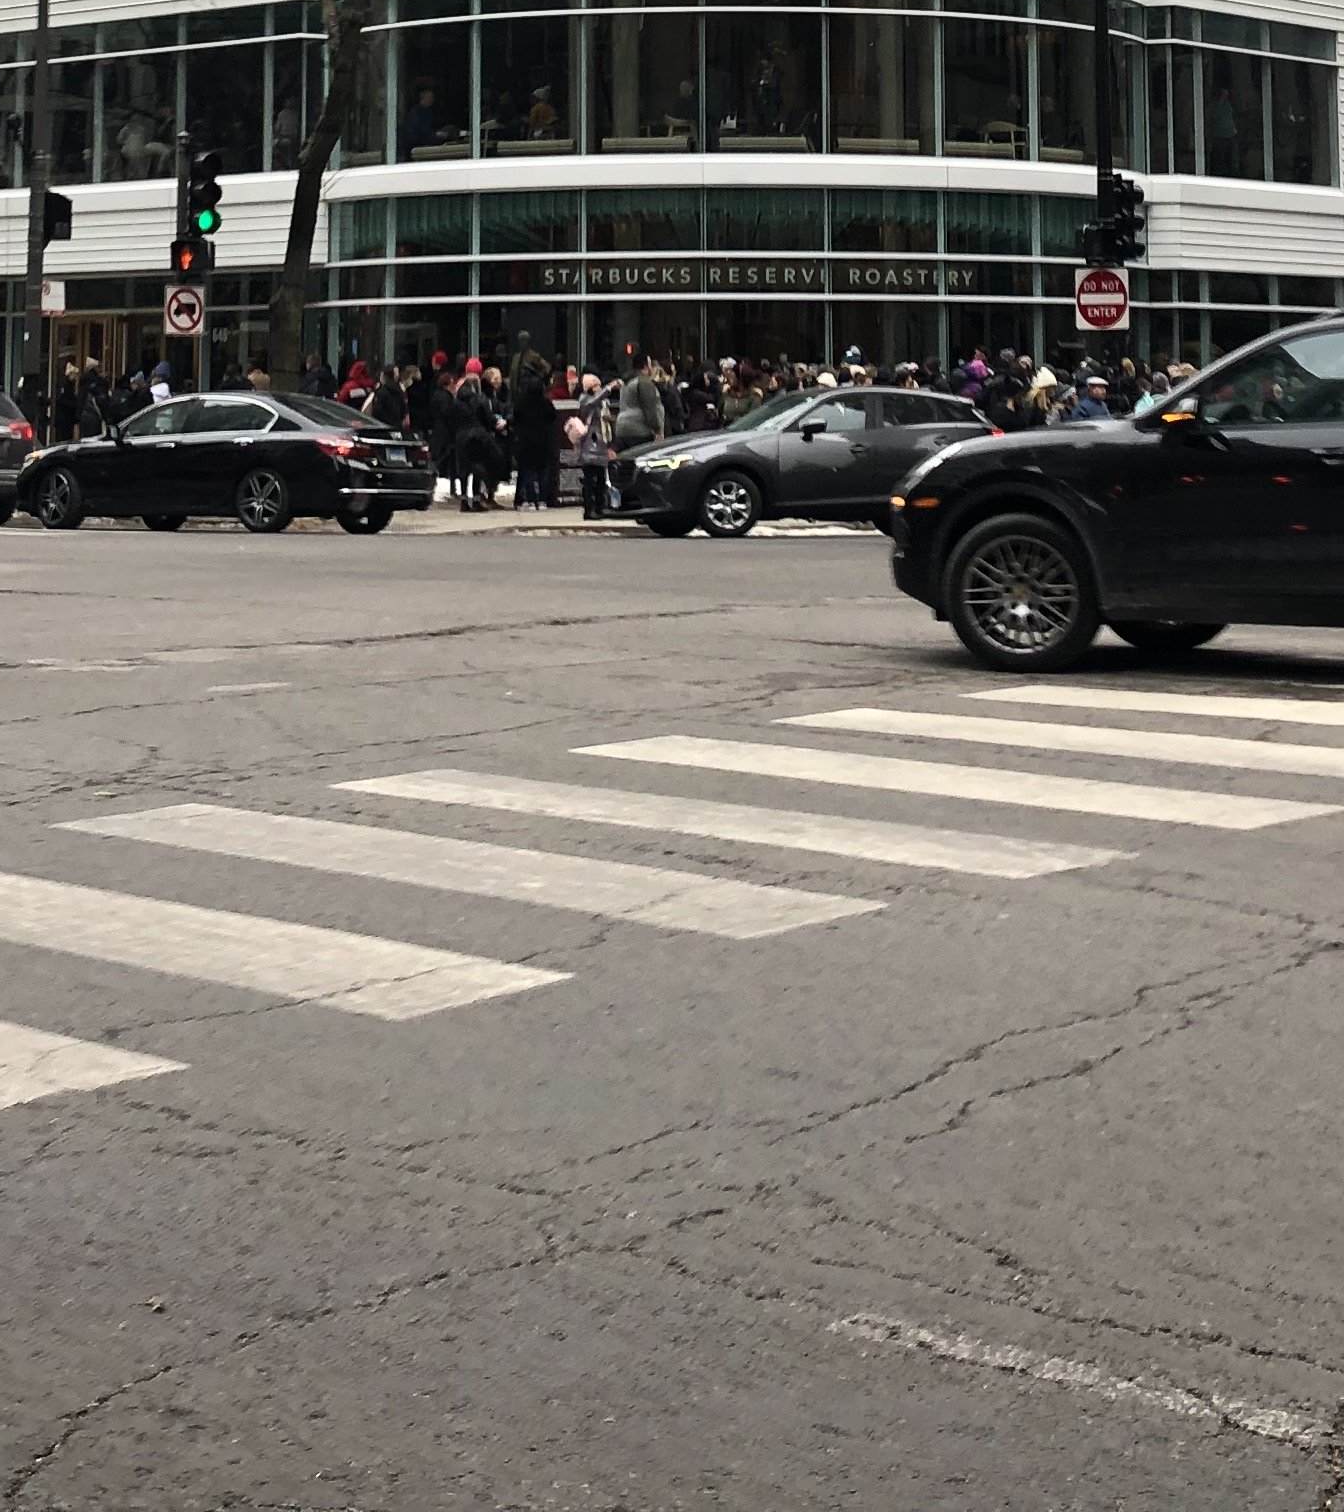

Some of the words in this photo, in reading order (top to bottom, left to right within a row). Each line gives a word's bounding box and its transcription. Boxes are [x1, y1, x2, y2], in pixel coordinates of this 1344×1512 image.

[1083, 280, 1097, 292] DO
[1101, 280, 1120, 292] NOT
[1087, 306, 1117, 318] ENTER
